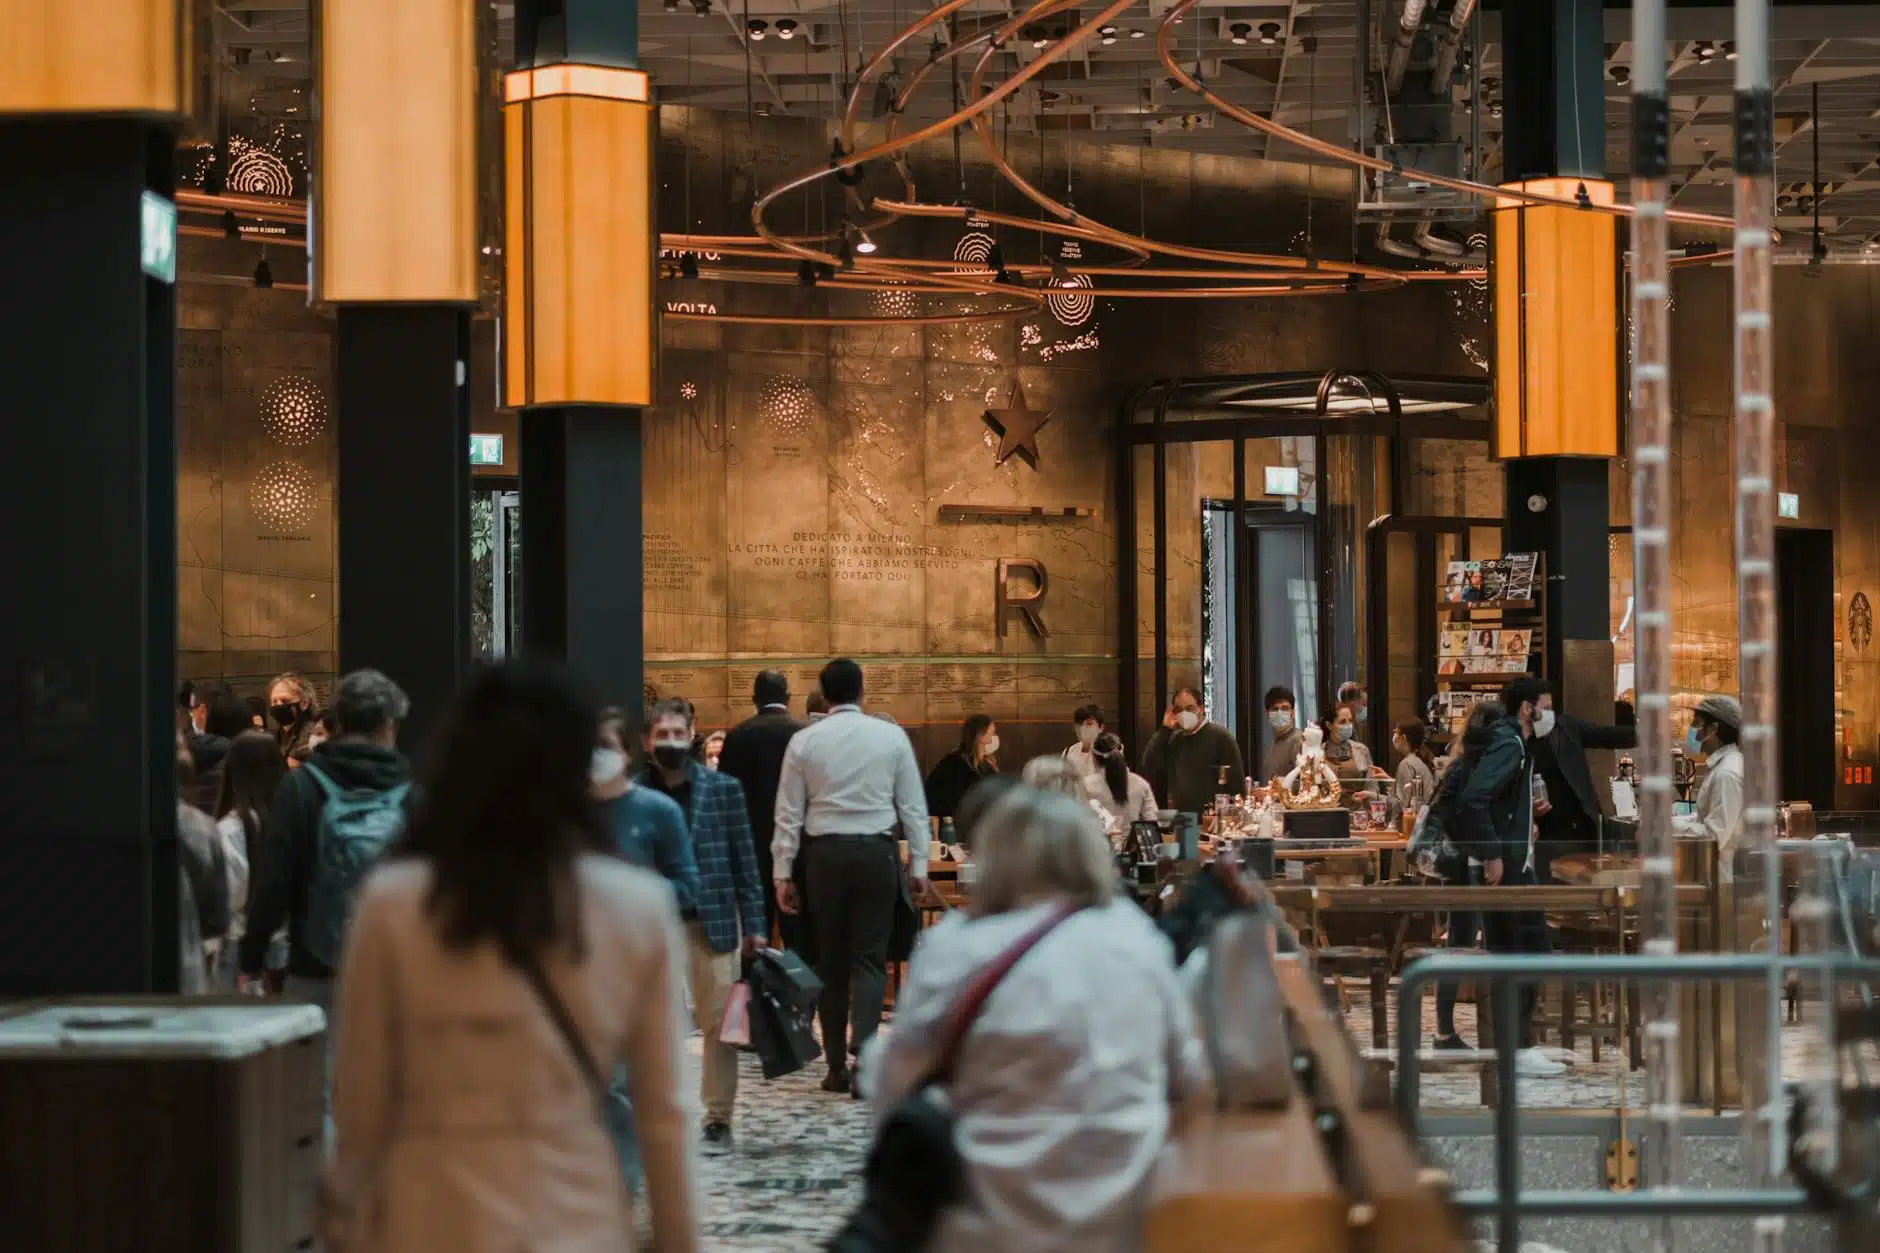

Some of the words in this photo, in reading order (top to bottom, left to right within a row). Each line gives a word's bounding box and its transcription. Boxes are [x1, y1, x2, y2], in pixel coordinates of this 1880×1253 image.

[792, 531, 851, 542] DEDICATO
[856, 533, 863, 542] A
[727, 543, 742, 553] LA
[783, 544, 805, 554] CHE
[810, 545, 825, 555] HA
[831, 546, 882, 556] ISPIRATO
[754, 556, 785, 567] OGNI
[830, 558, 853, 568] CHE
[858, 559, 909, 569] ABBIAMO
[913, 560, 959, 570] SERVITO
[835, 571, 883, 581] PORTATO
[995, 558, 1050, 637] R
